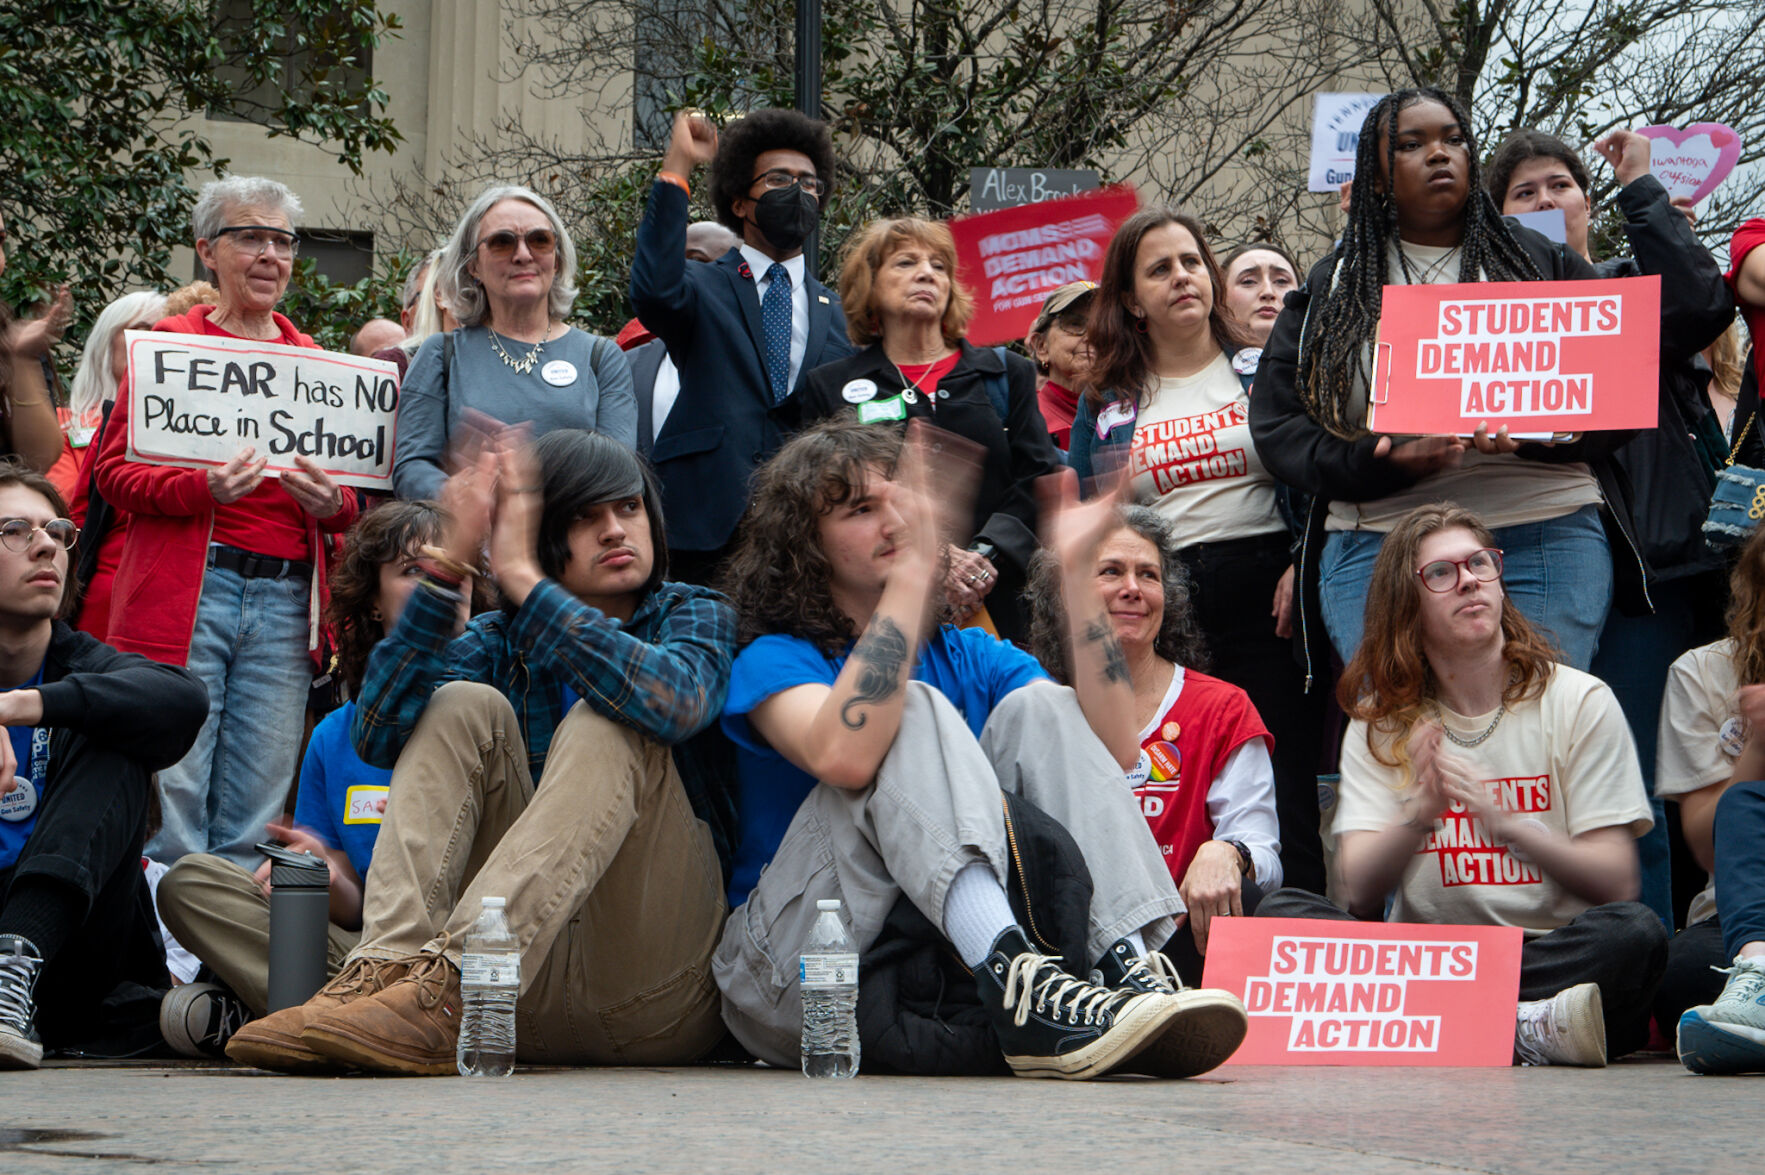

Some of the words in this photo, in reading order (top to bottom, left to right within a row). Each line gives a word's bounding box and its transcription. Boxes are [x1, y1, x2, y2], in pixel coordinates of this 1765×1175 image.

[981, 168, 1028, 202] Alex
[1326, 168, 1353, 185] Gun
[984, 238, 1103, 279] DEMAND
[991, 262, 1090, 300] ACTION
[1442, 299, 1618, 336] STUDENTS
[1420, 340, 1556, 374] DEMAND
[154, 350, 279, 398] FEAR
[293, 366, 344, 407] has
[355, 374, 398, 413] NO
[1465, 378, 1587, 413] ACTION
[144, 395, 227, 436] Place
[237, 408, 259, 439] in
[268, 409, 385, 467] School
[1131, 400, 1249, 450] STUDENTS
[1130, 433, 1215, 477] EMAND
[1156, 450, 1247, 495] ACTION
[2, 792, 25, 804] UNITED
[1418, 818, 1508, 851] EMAN
[1444, 852, 1540, 884] ACTION
[1273, 940, 1474, 977] STUDENTS
[1247, 981, 1402, 1013] DEMAND
[1293, 1019, 1436, 1049] ACTION
